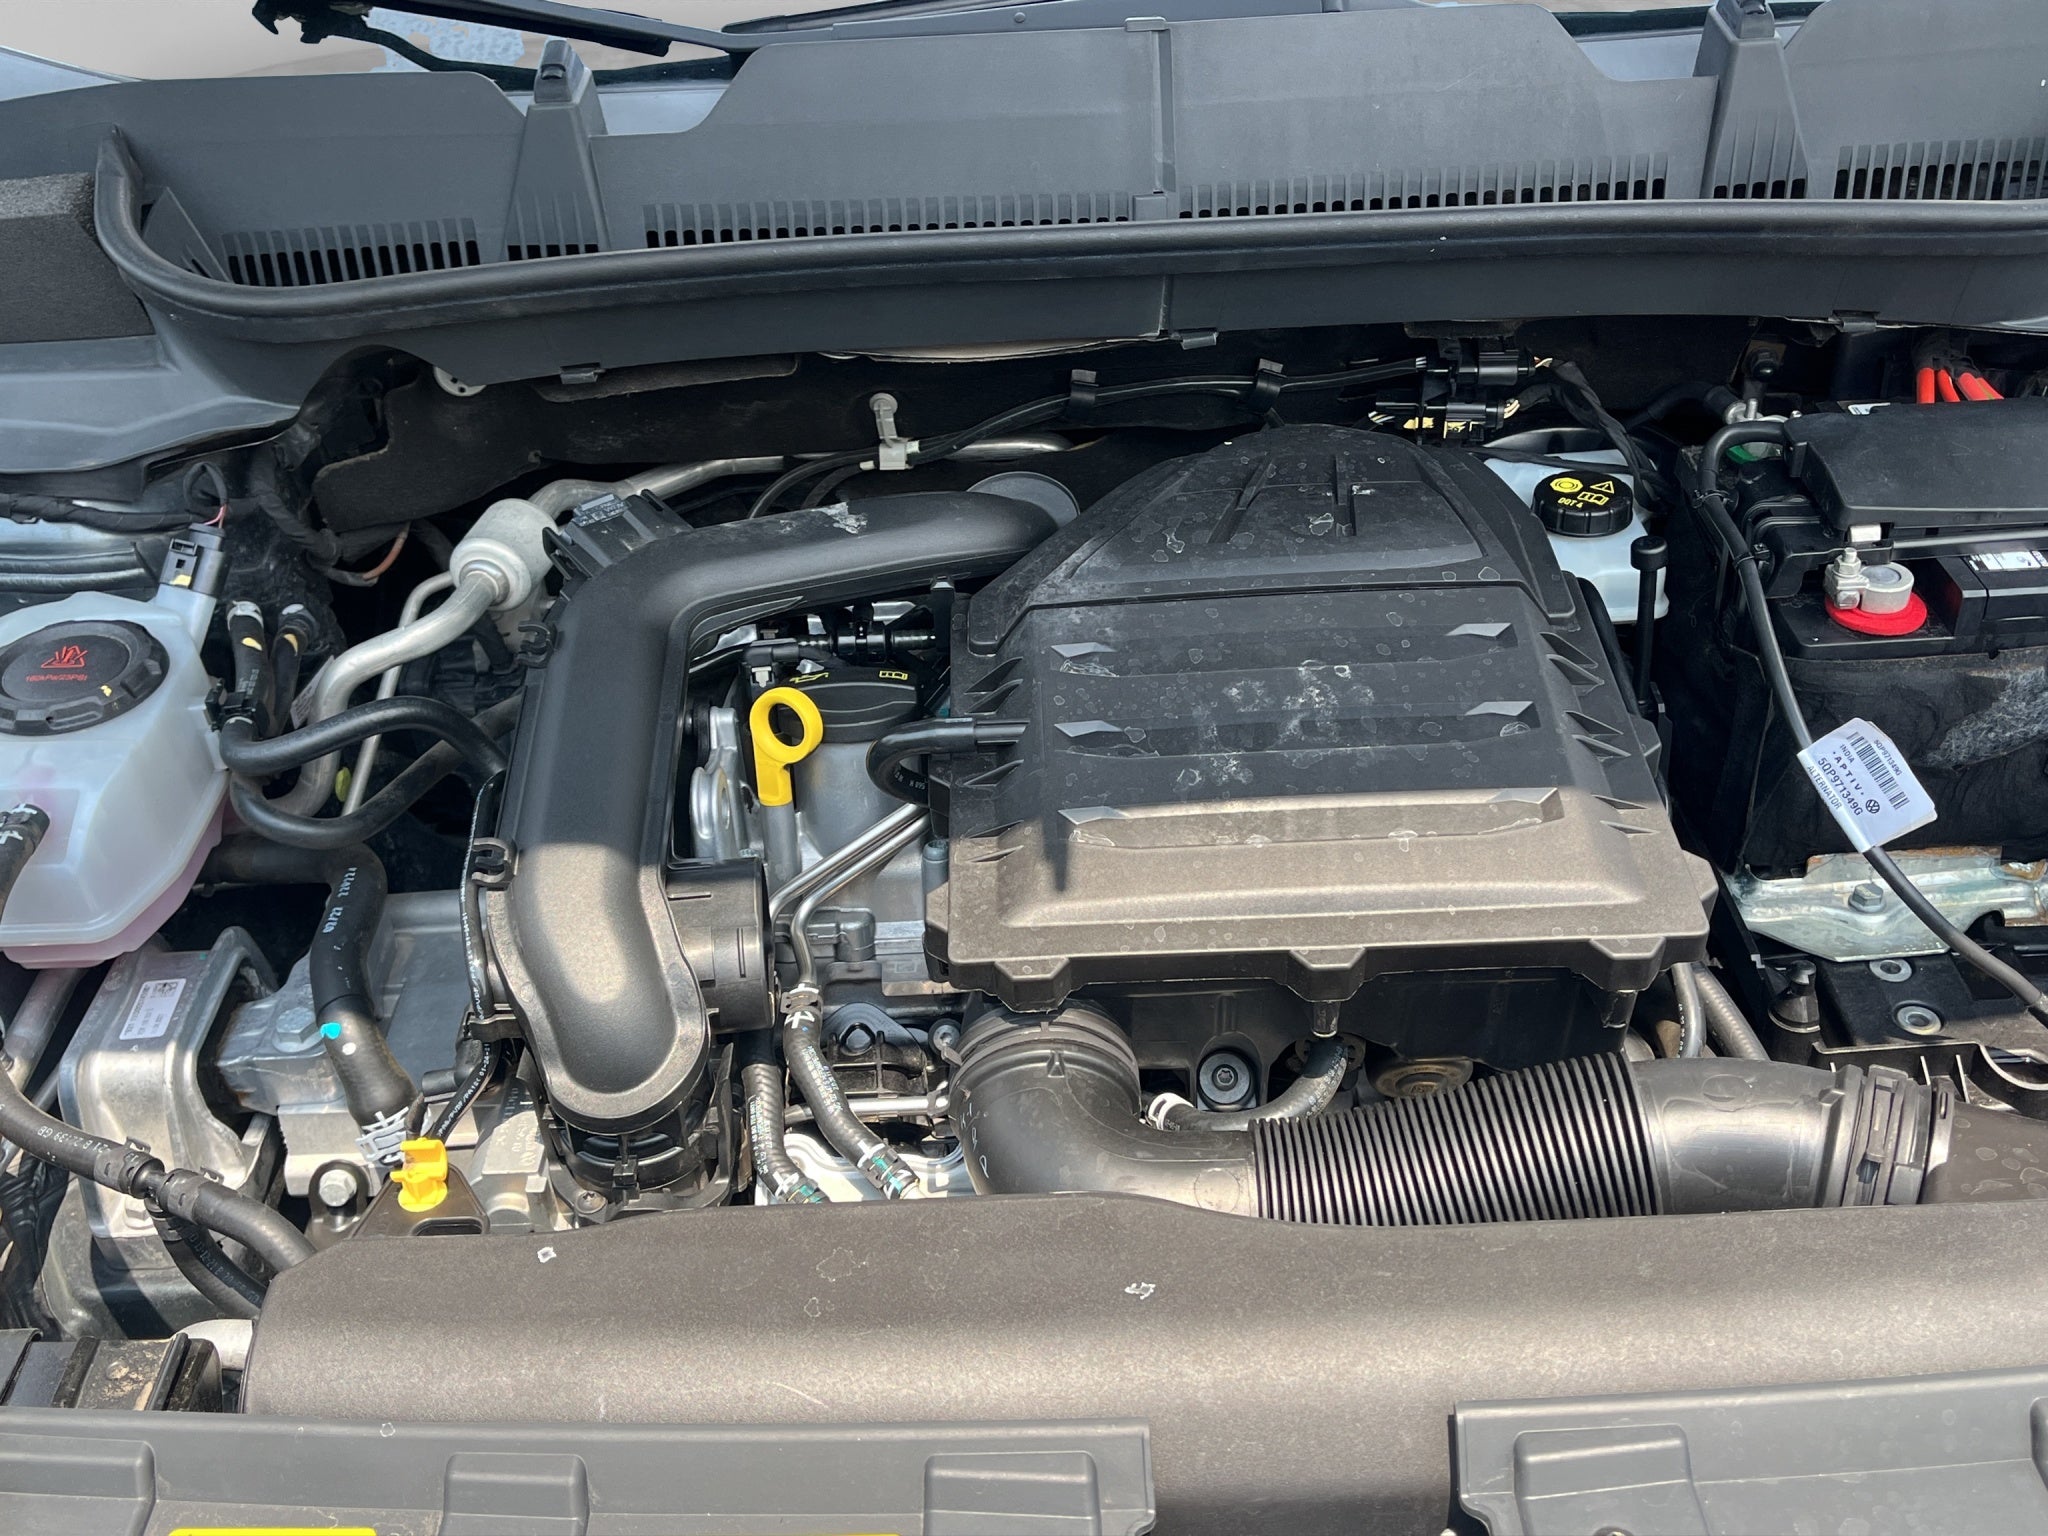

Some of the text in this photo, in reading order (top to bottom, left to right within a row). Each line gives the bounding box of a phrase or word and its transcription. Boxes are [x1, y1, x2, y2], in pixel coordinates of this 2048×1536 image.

[1557, 497, 1577, 507] DOT
[1840, 743, 1855, 764] INDIA
[1807, 765, 1843, 810] ALTERNATOR
[1817, 757, 1863, 816] 5QP971349G
